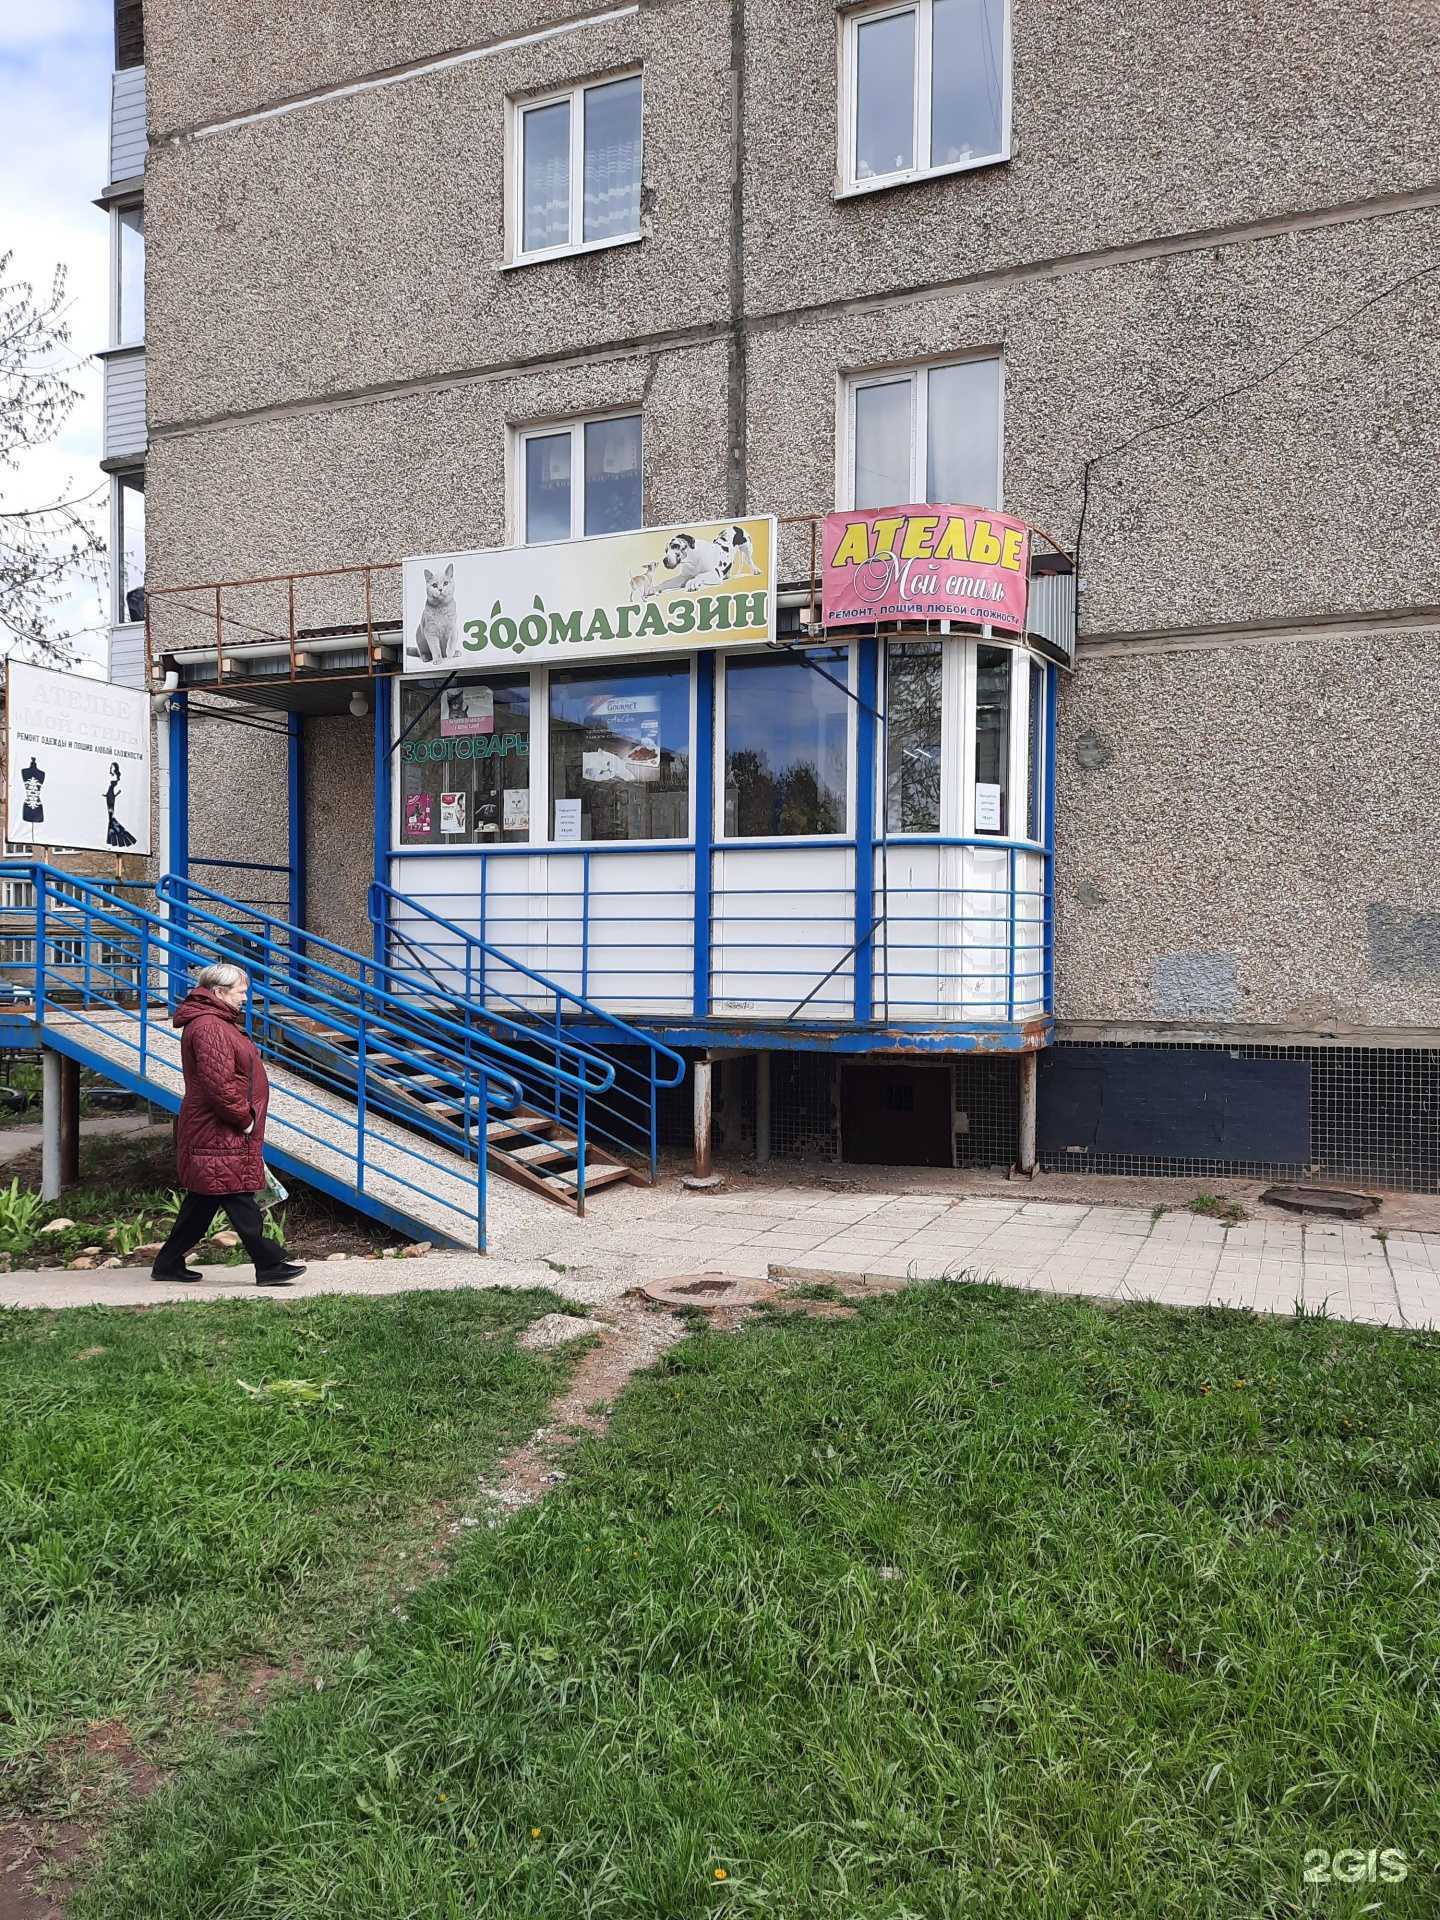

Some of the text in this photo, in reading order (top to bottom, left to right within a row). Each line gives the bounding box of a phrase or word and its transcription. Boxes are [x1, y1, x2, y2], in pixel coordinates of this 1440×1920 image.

[832, 516, 1023, 571] АТЕЛЬЕ
[854, 551, 1005, 602] Мой стиль
[462, 591, 768, 655] ЗООМАГАЗИН
[828, 608, 877, 619] РЕМОНТ,
[880, 604, 923, 614] ПОШИВ
[16, 732, 40, 743] РЕМОНТ
[41, 736, 66, 748] ОДЕЖДЫ
[73, 742, 93, 752] ПОШИВ
[94, 745, 113, 755] ЛЮБОЙ
[113, 749, 143, 761] СЛОЖНОСТИ
